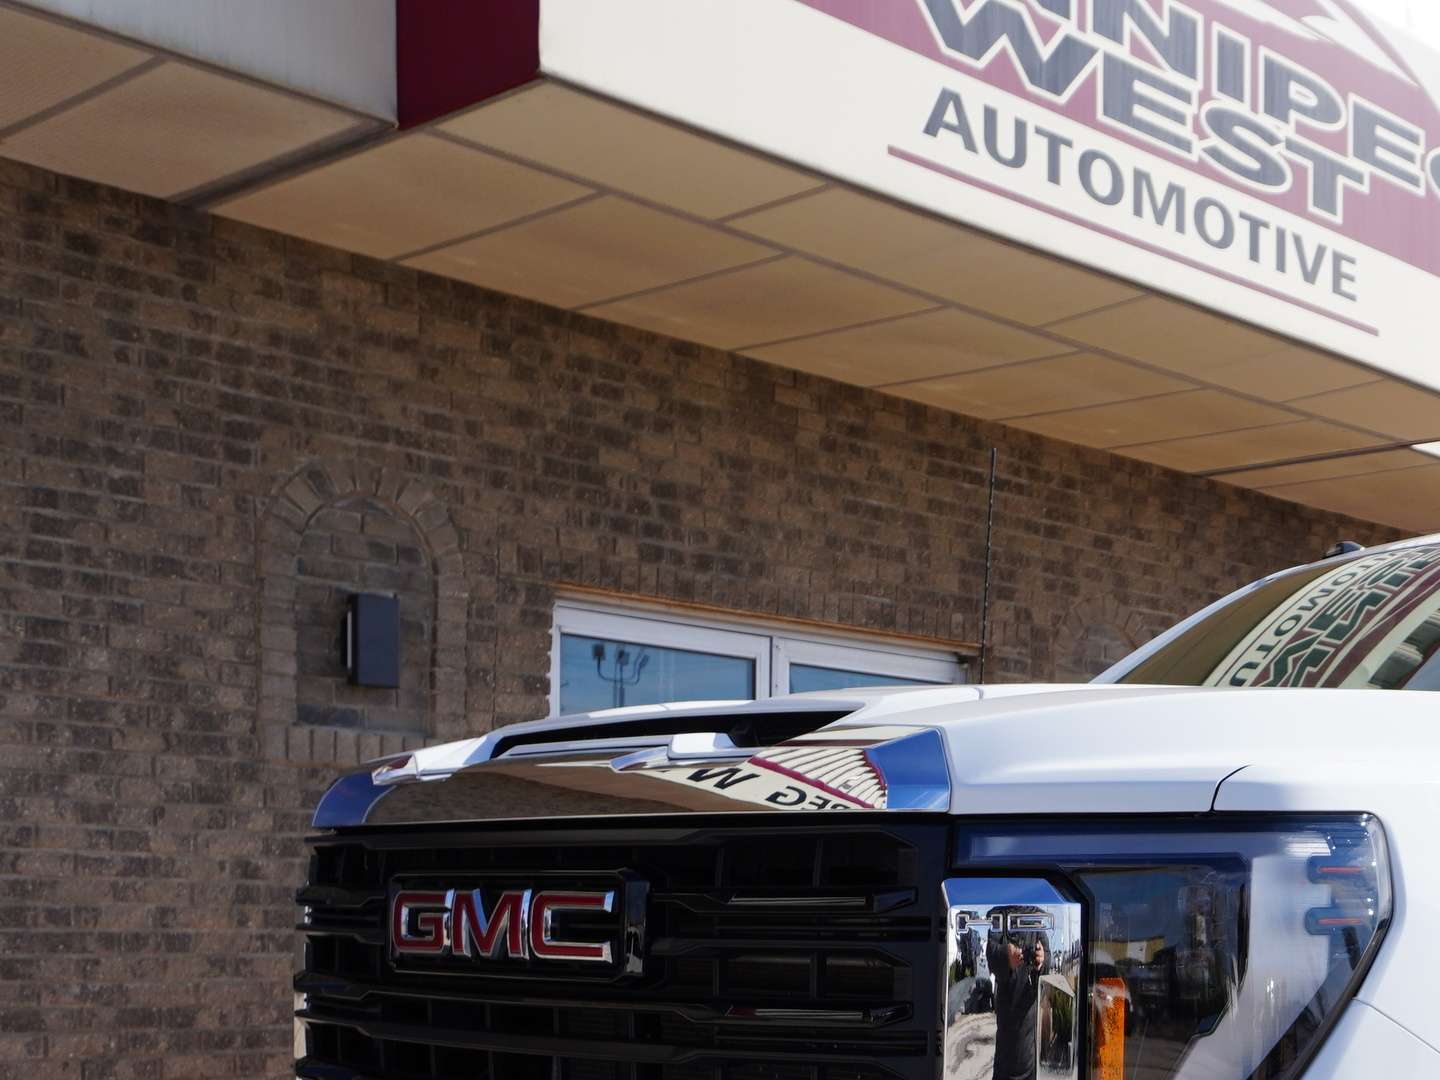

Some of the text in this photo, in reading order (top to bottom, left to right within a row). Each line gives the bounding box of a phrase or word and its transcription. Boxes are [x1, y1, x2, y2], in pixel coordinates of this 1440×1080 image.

[922, 0, 1369, 216] WEST
[922, 86, 1358, 301] AUTOMOTIVE
[391, 888, 616, 964] GMC
[956, 912, 1056, 934] HD
